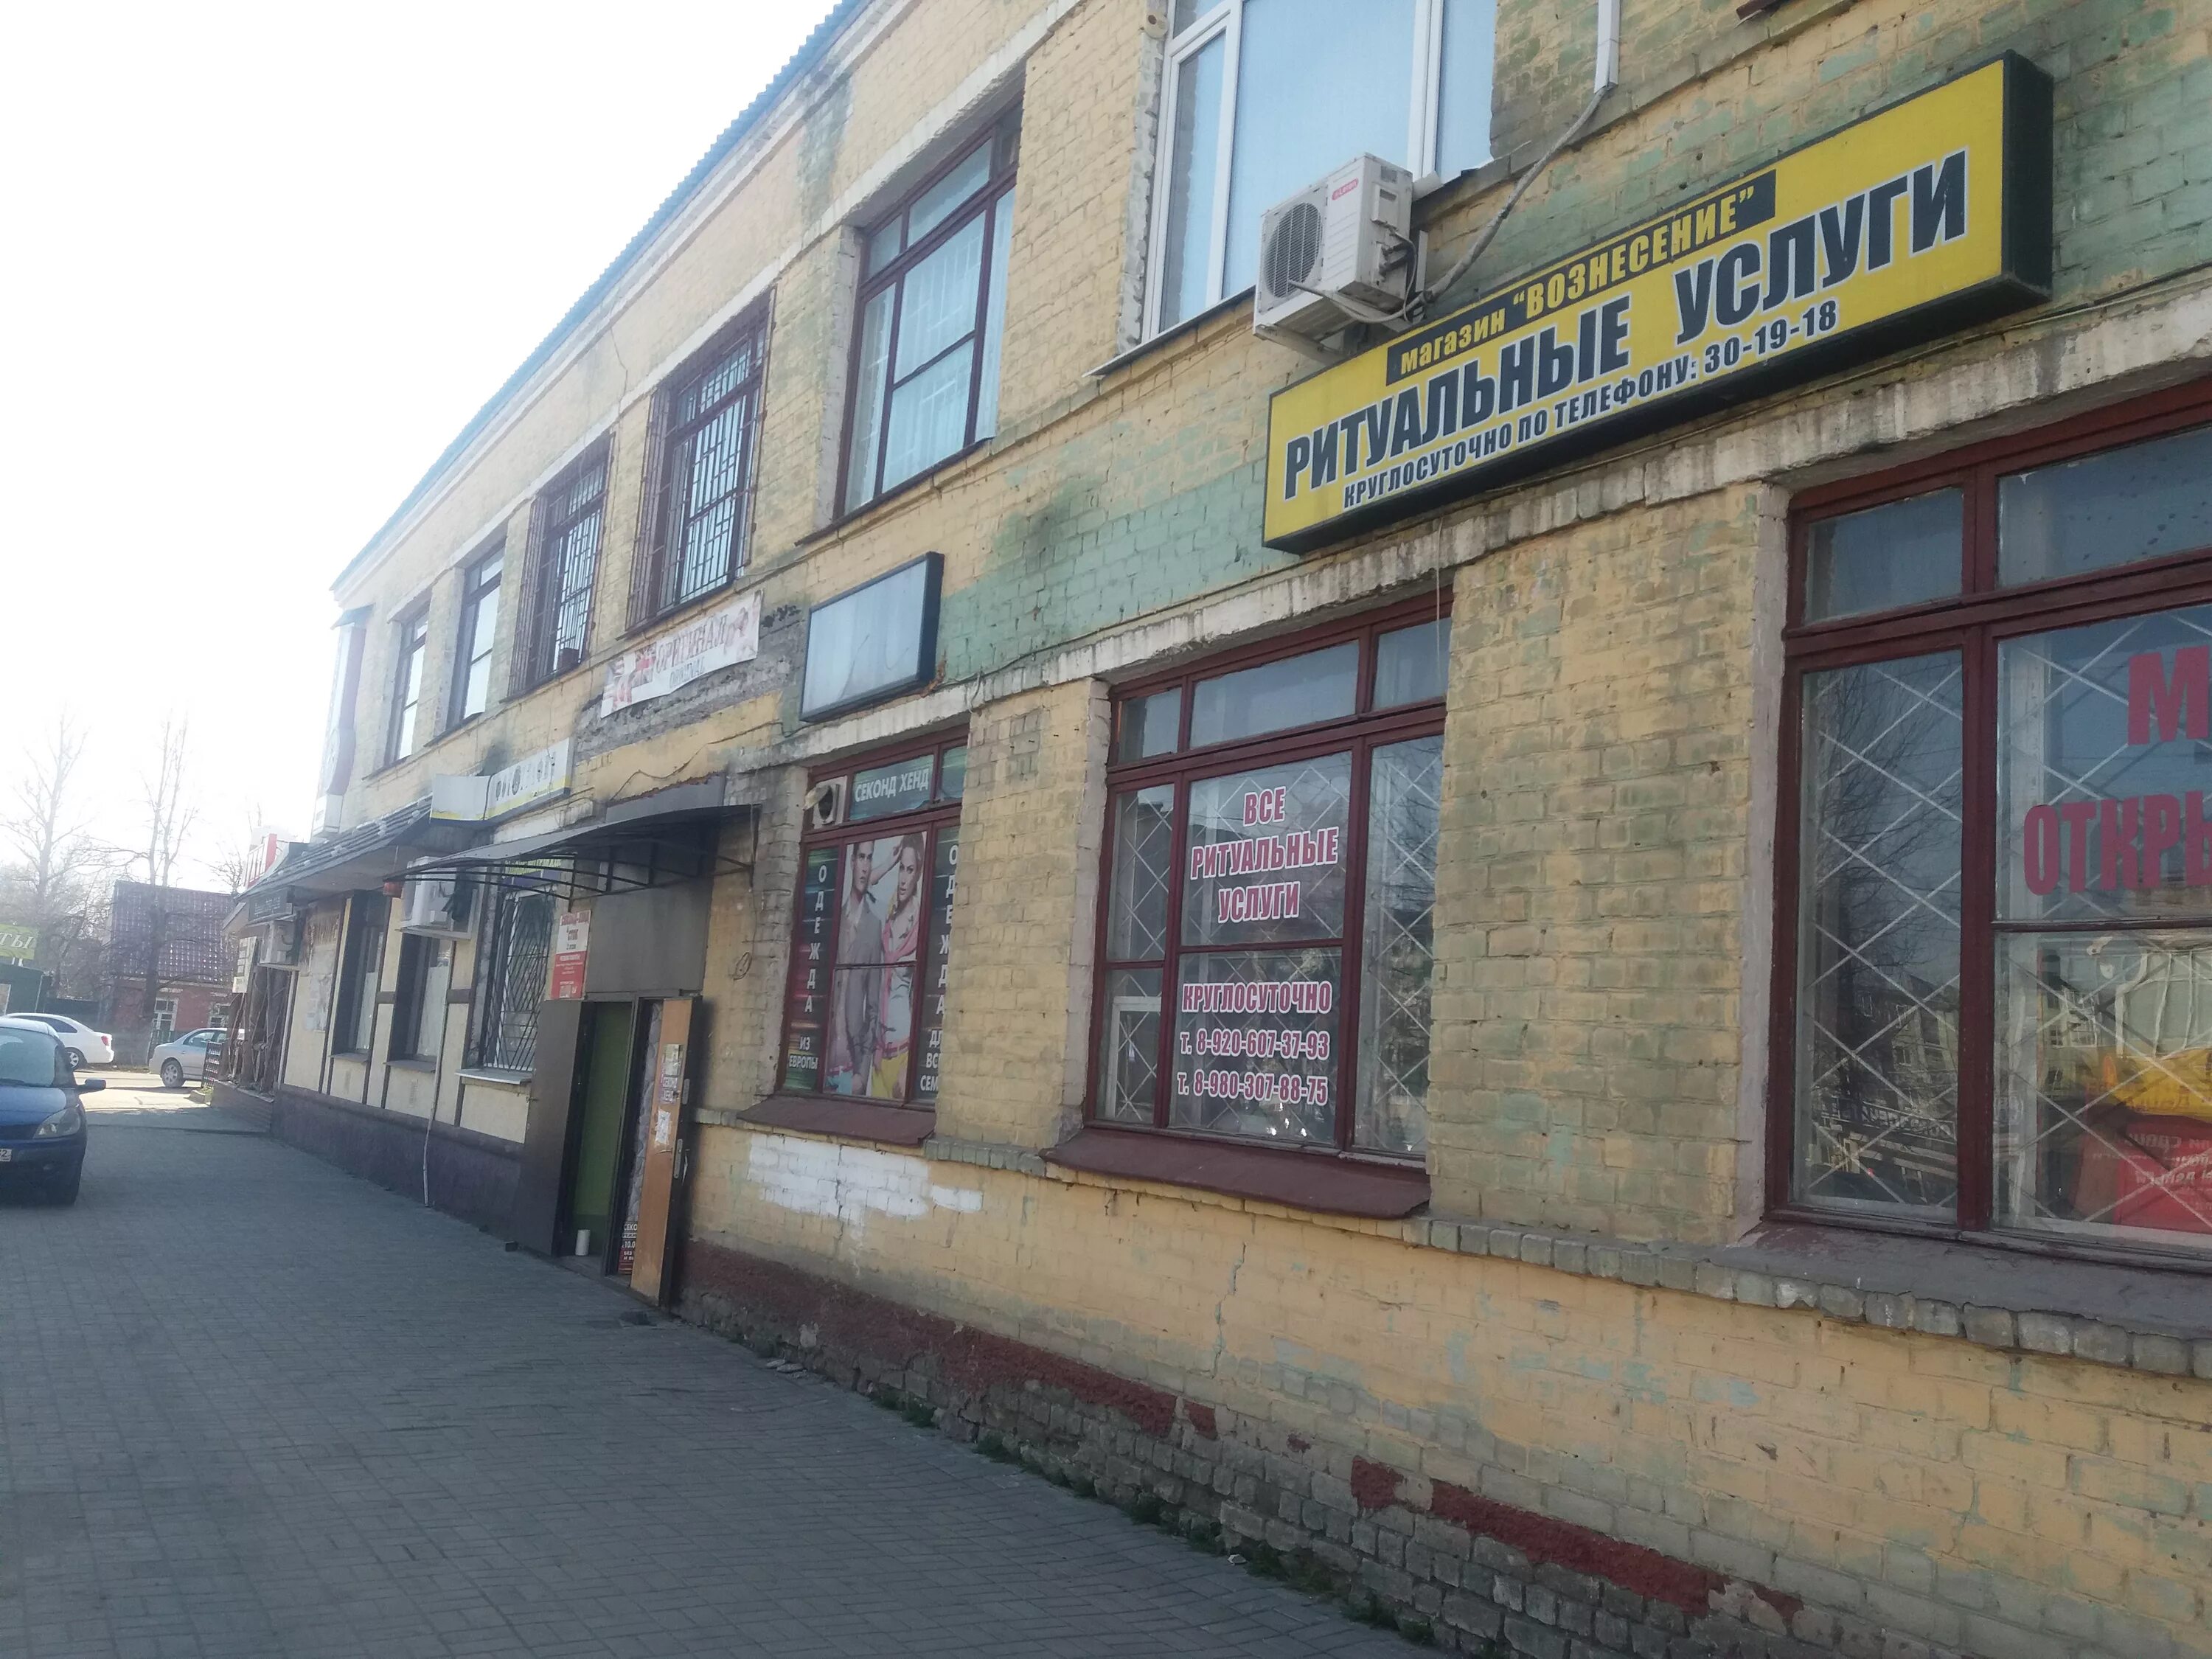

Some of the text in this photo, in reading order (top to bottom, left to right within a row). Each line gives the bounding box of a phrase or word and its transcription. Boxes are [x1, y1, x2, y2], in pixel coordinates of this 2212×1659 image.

[1284, 147, 1969, 501] РИТУАЛЬНЫЕ УСЛУГИ
[1400, 310, 1505, 372] магазин
[1343, 299, 1839, 509] КРУГЛОСУТОЧНО ПО ТЕЛЕФОНУ: 30-19-18
[855, 768, 929, 803] СЕКОНД ХЕНД
[1243, 786, 1287, 826] ВСЕ
[1189, 827, 1339, 880] РИТУАЛЬНЫЕ
[1218, 881, 1300, 924] УСЛУГИ
[804, 864, 827, 1012] ОДЕЖДА
[1182, 981, 1333, 1014] КРУГЛОСУТОЧНО
[788, 1054, 819, 1070] ЕВРОПЫ
[799, 1035, 811, 1051] ИЗ
[1197, 1029, 1329, 1061] 8-920-607-37-93
[1193, 1071, 1328, 1106] 8-980-307-88-75
